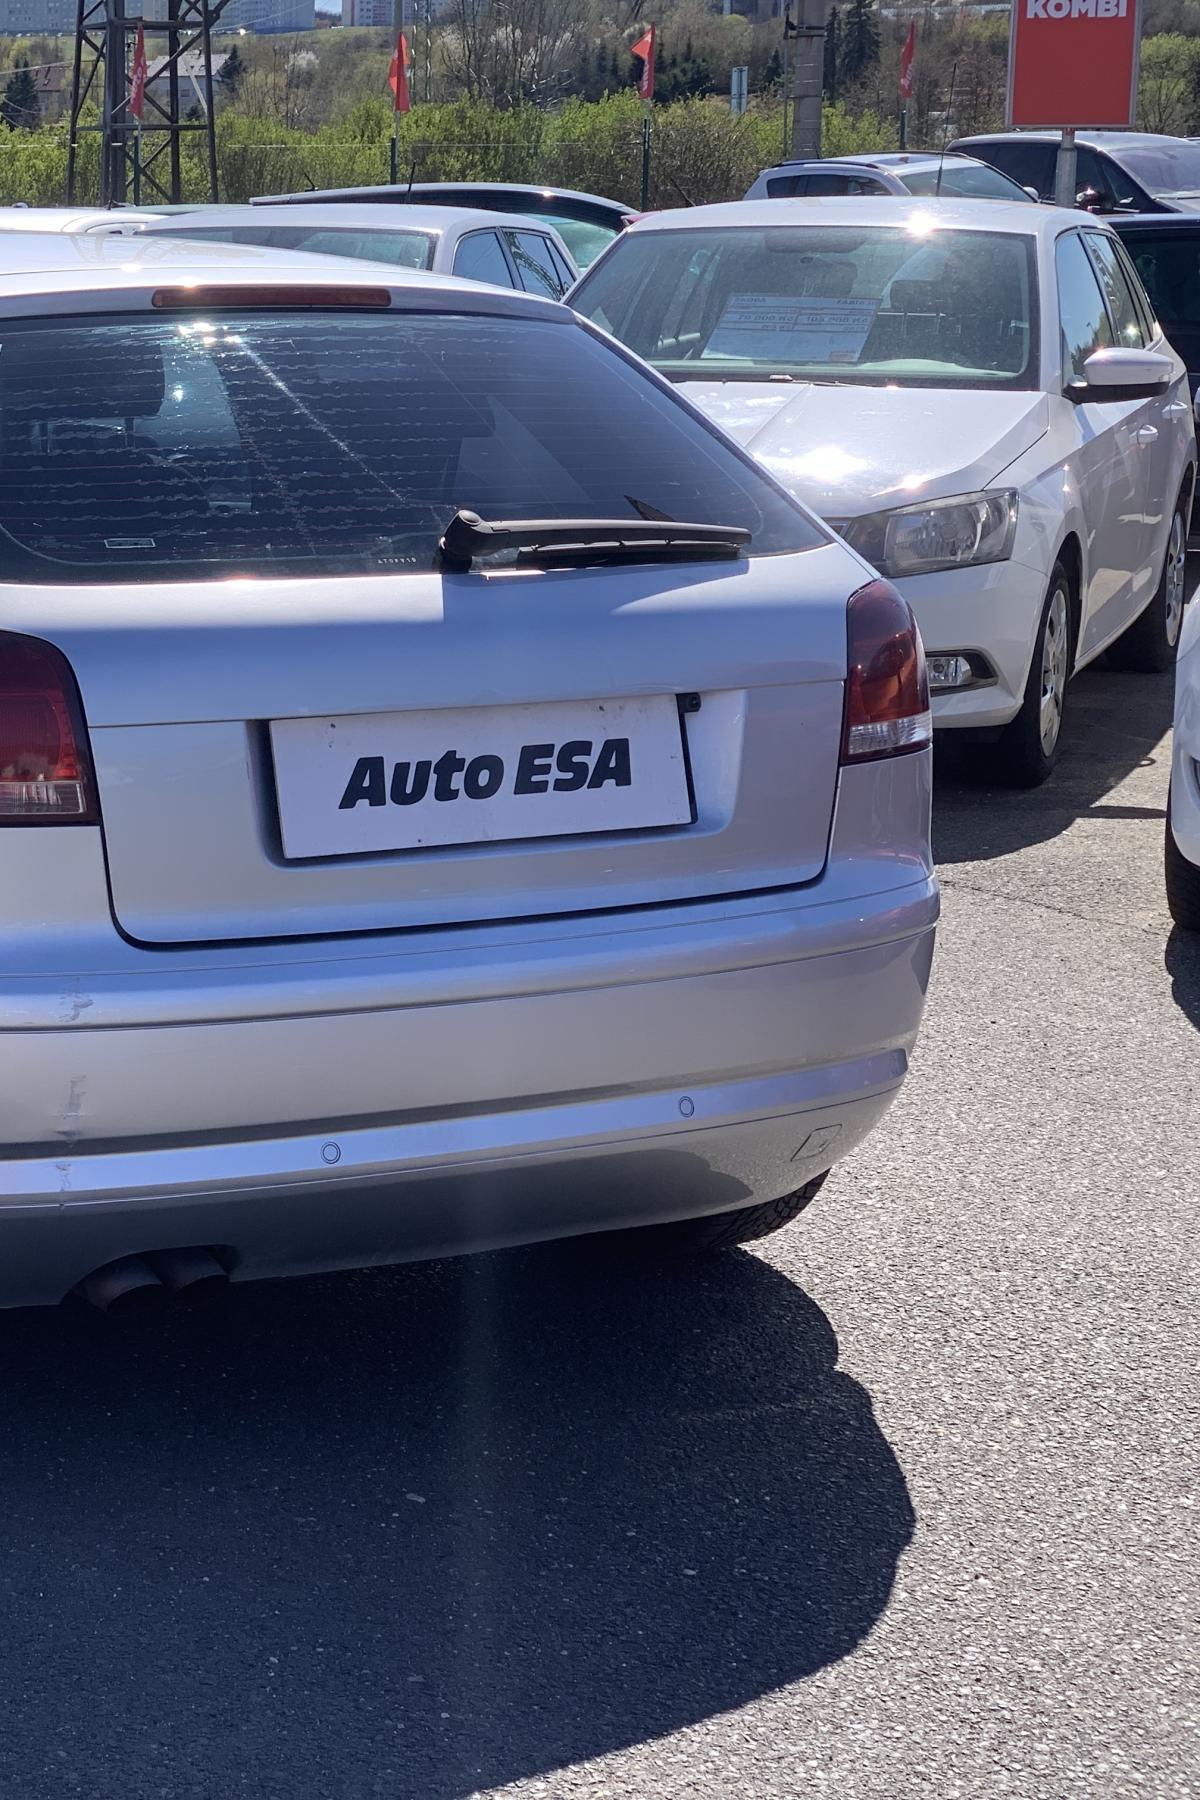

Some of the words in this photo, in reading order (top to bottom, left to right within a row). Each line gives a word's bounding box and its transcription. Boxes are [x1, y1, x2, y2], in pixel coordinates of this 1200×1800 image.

[1026, 0, 1128, 19] KOMBI
[338, 749, 504, 810] Auto
[513, 737, 632, 796] ESA
